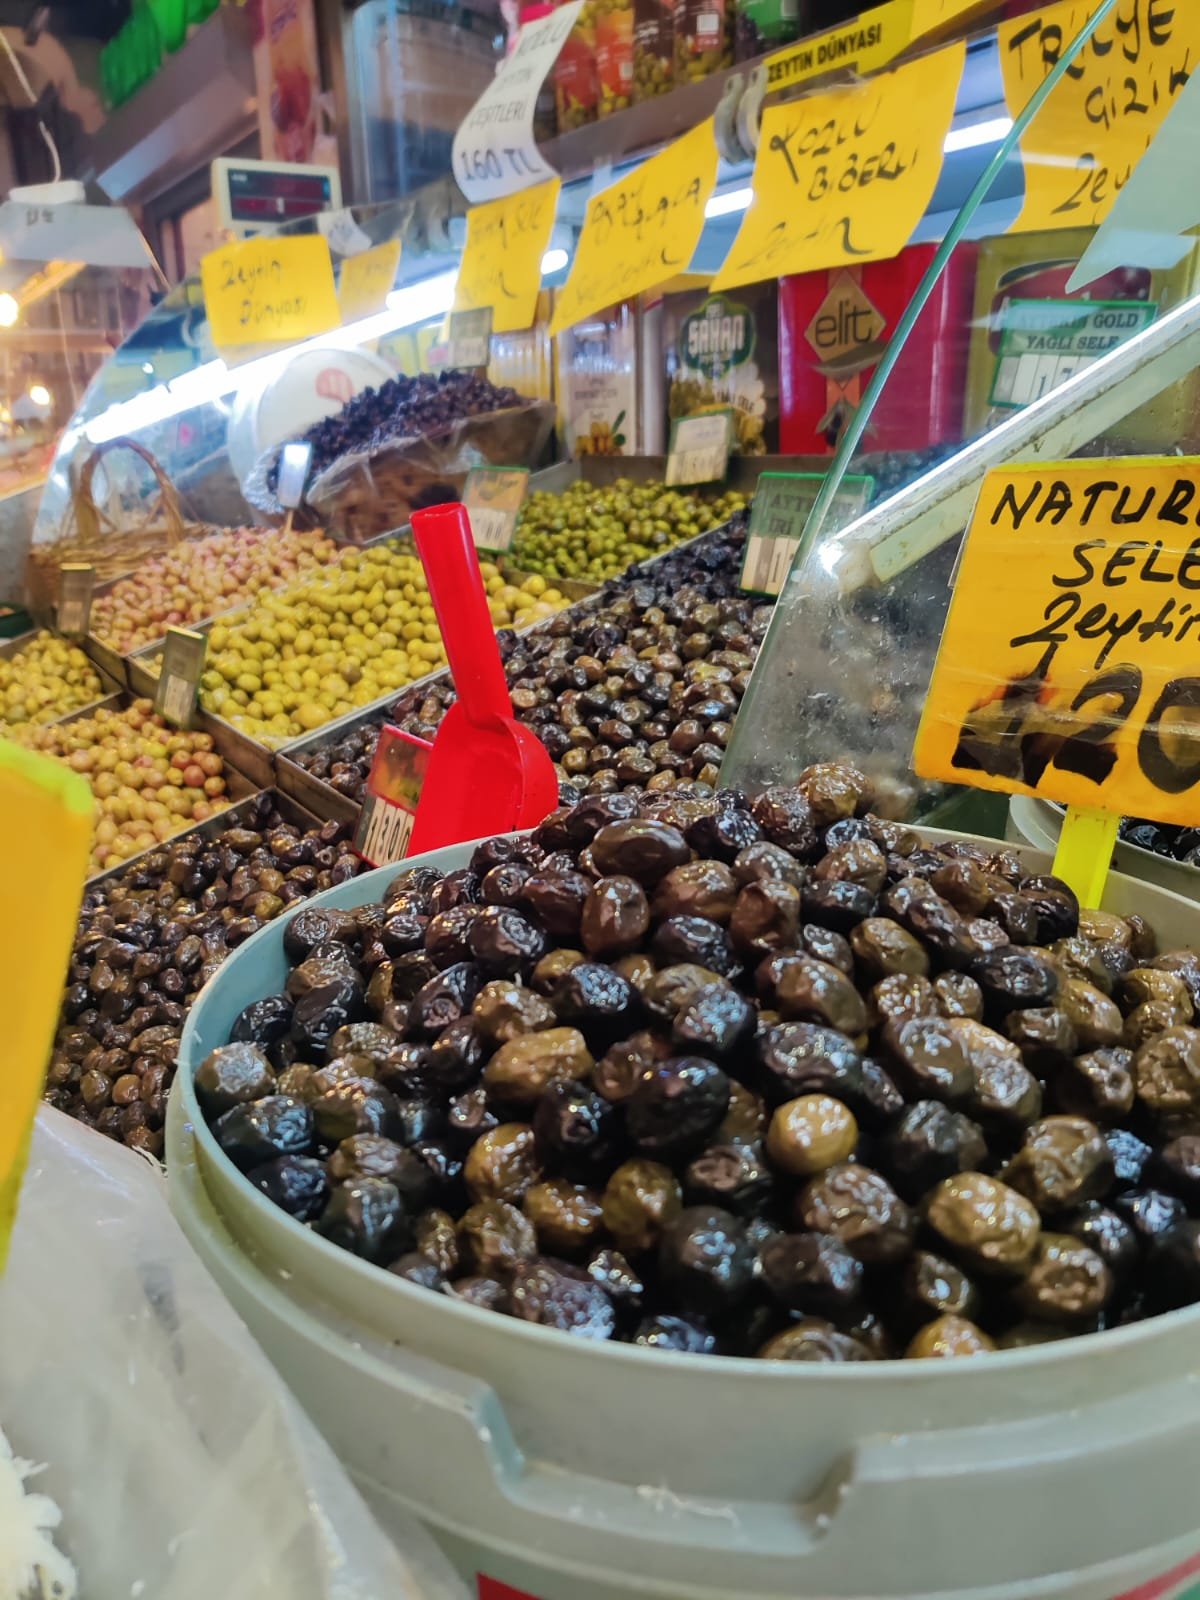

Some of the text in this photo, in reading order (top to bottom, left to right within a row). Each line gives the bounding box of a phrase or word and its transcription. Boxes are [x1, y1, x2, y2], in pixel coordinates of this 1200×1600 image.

[817, 23, 882, 63] DÜNYASI
[461, 148, 542, 180] 160 TL
[815, 301, 872, 348] elit
[1092, 312, 1139, 328] GOLD
[991, 479, 1200, 530] NATUR
